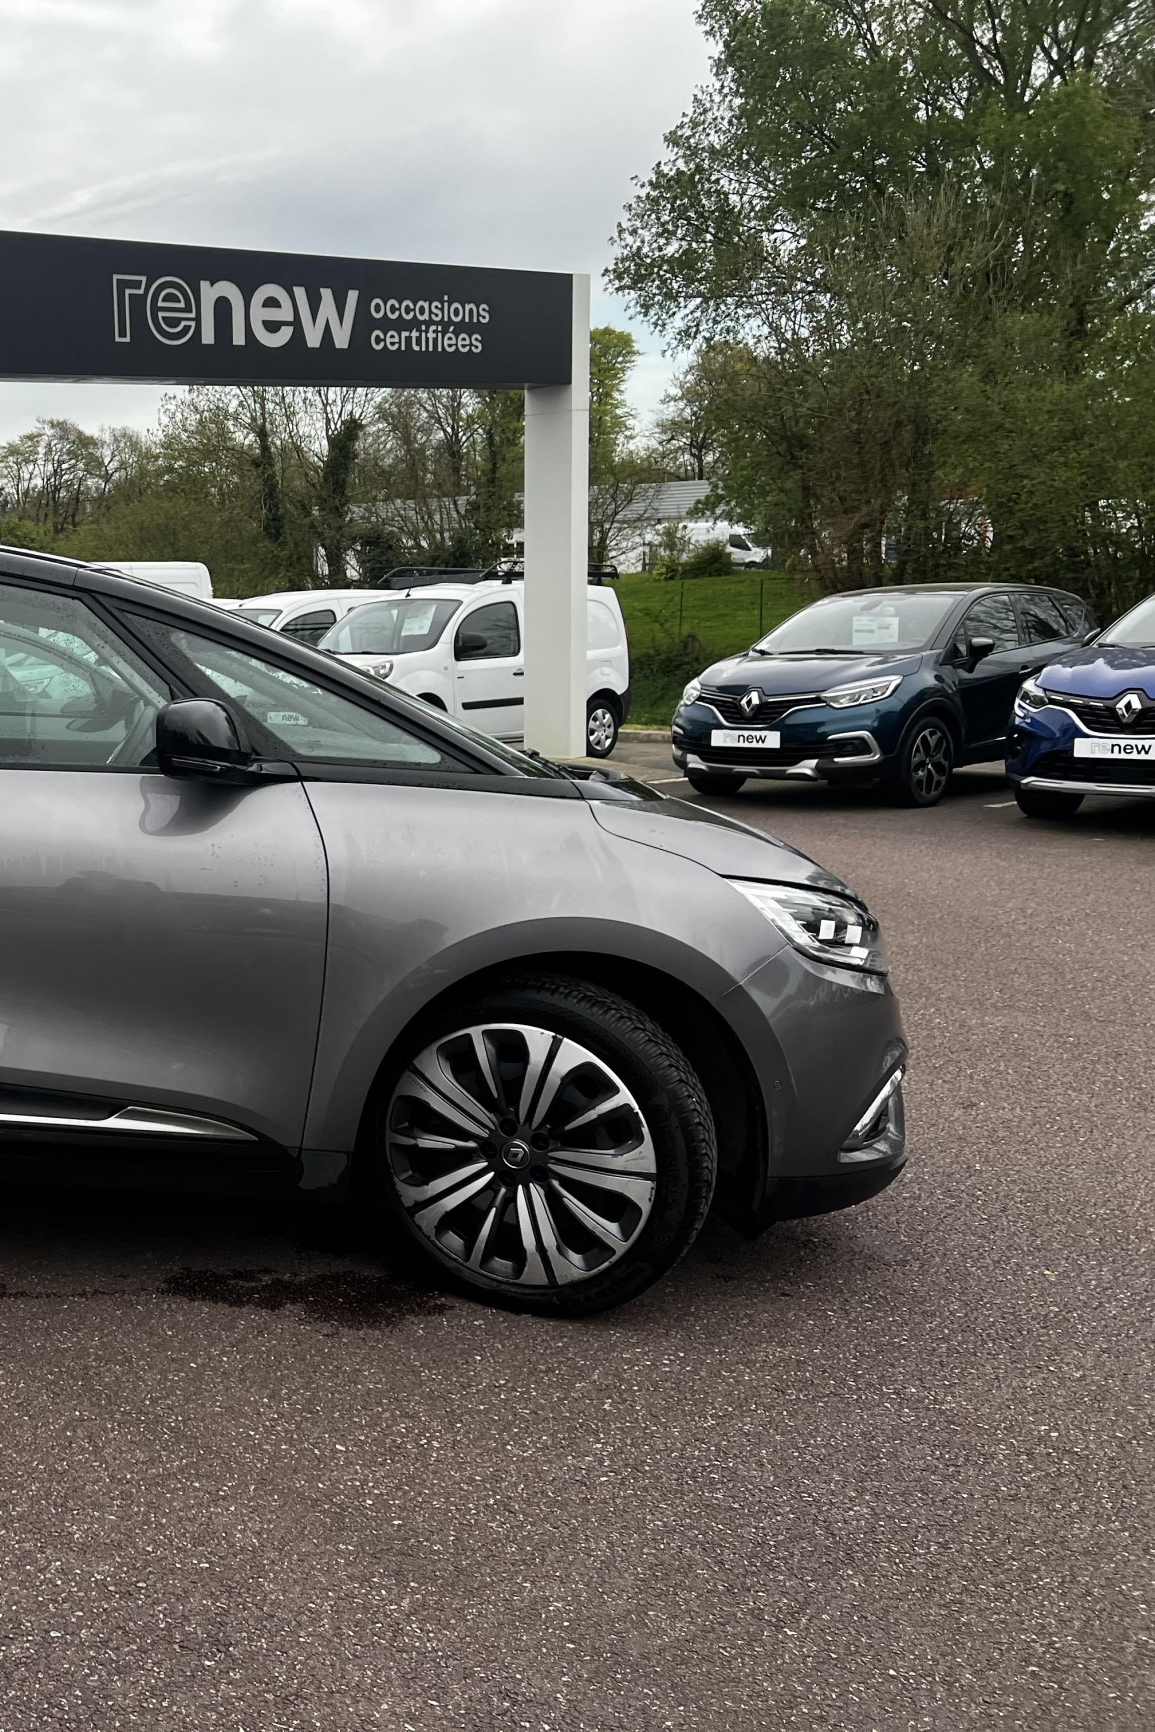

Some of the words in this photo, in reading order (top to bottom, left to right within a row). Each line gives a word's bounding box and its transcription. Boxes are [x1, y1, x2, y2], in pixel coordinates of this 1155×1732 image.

[112, 273, 359, 349] renew
[370, 294, 490, 324] occasions
[370, 325, 482, 353] certifiées
[1090, 742, 1153, 756] renew
